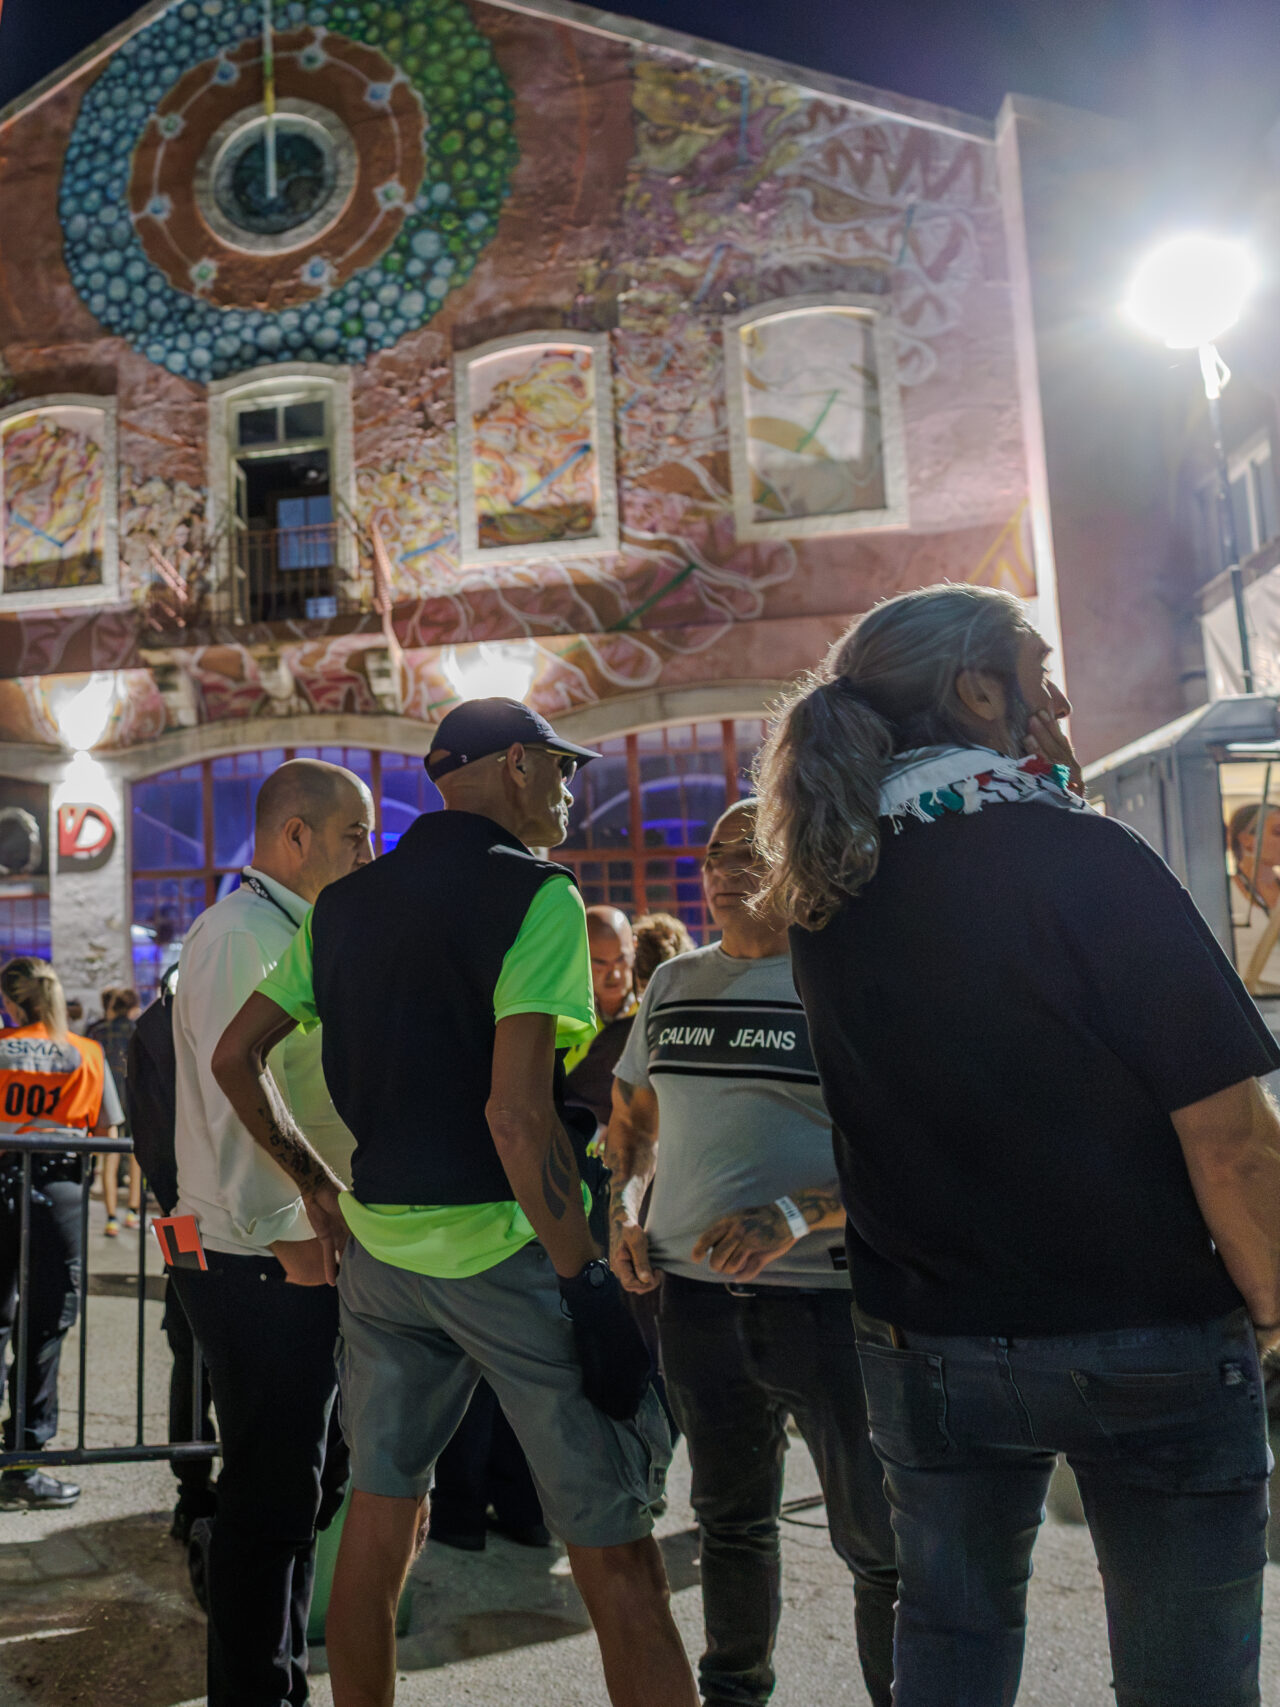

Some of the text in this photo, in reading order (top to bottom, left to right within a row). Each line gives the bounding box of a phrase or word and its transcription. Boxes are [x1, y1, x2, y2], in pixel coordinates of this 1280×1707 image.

[658, 1027, 796, 1050] CALVIN JEANS
[5, 1082, 61, 1116] 001
